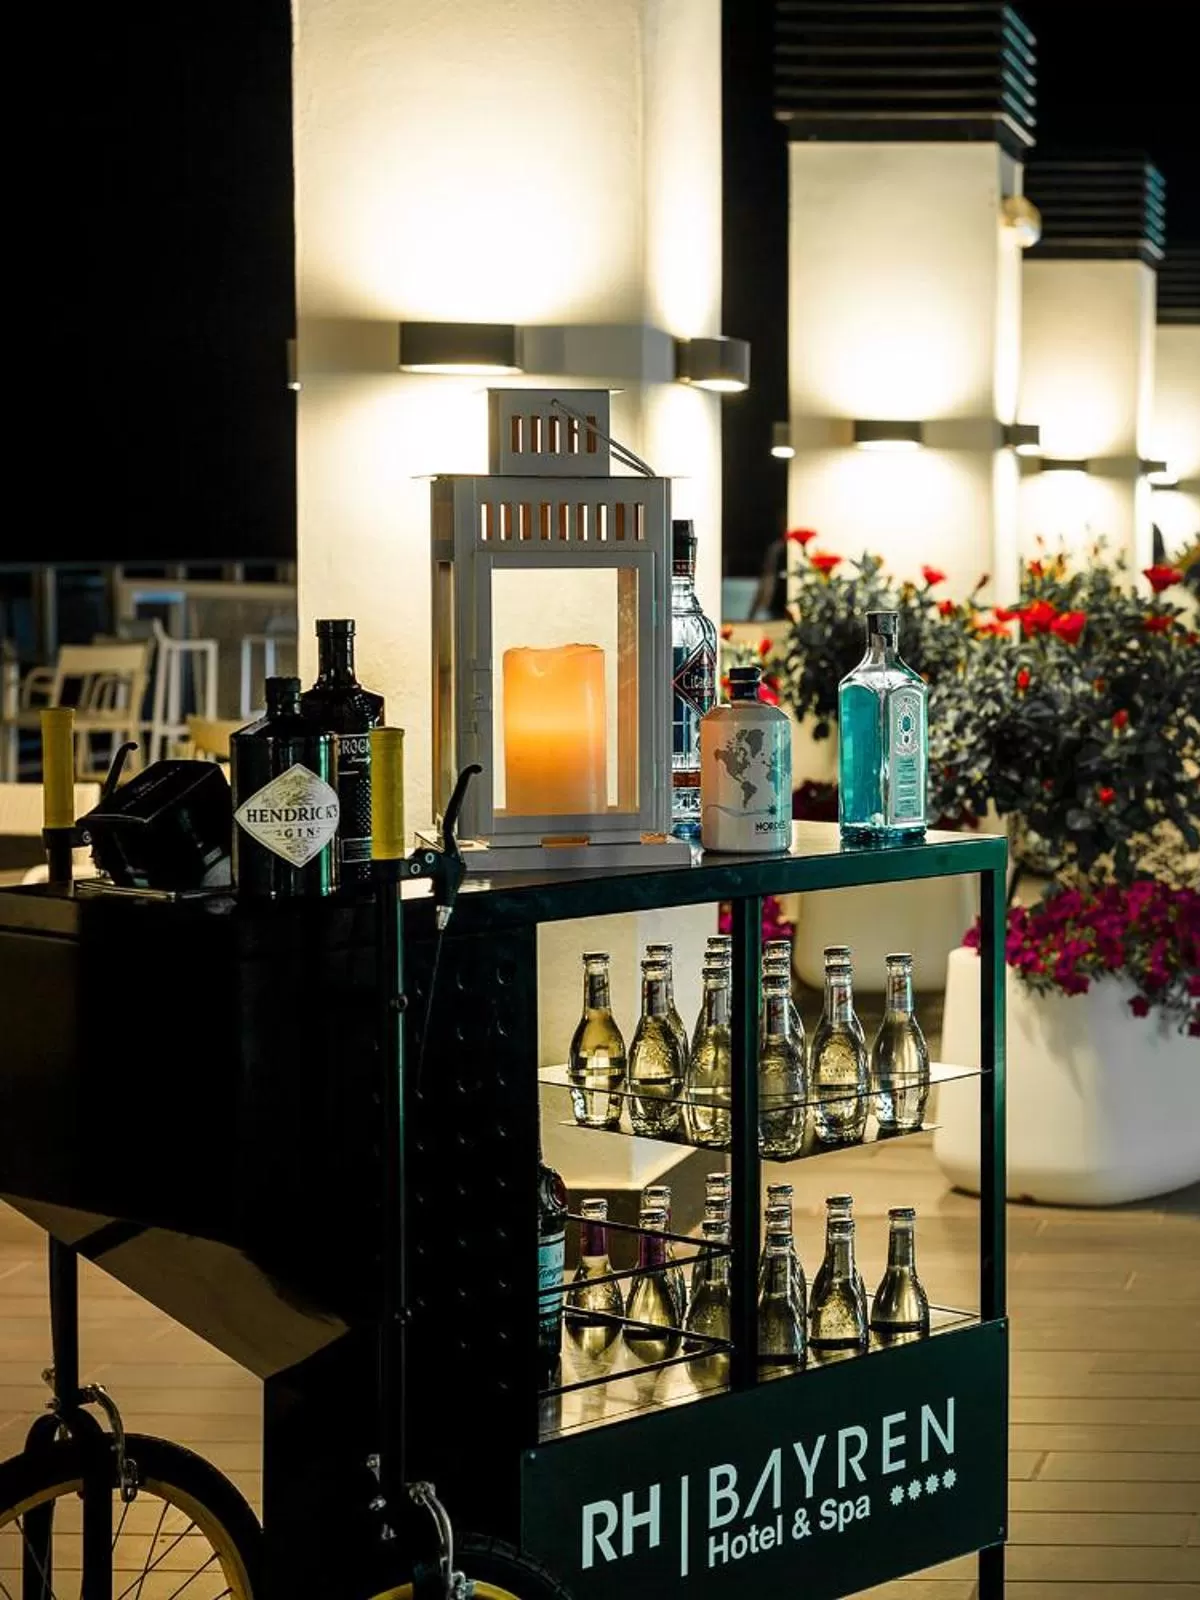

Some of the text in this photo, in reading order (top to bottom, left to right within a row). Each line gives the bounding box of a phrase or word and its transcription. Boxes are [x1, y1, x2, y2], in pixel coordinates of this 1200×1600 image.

[246, 804, 338, 823] HENDRICK'S
[284, 828, 315, 838] GIN
[581, 1397, 956, 1570] RH BAYREN
[708, 1494, 871, 1569] Hotel & Spa
